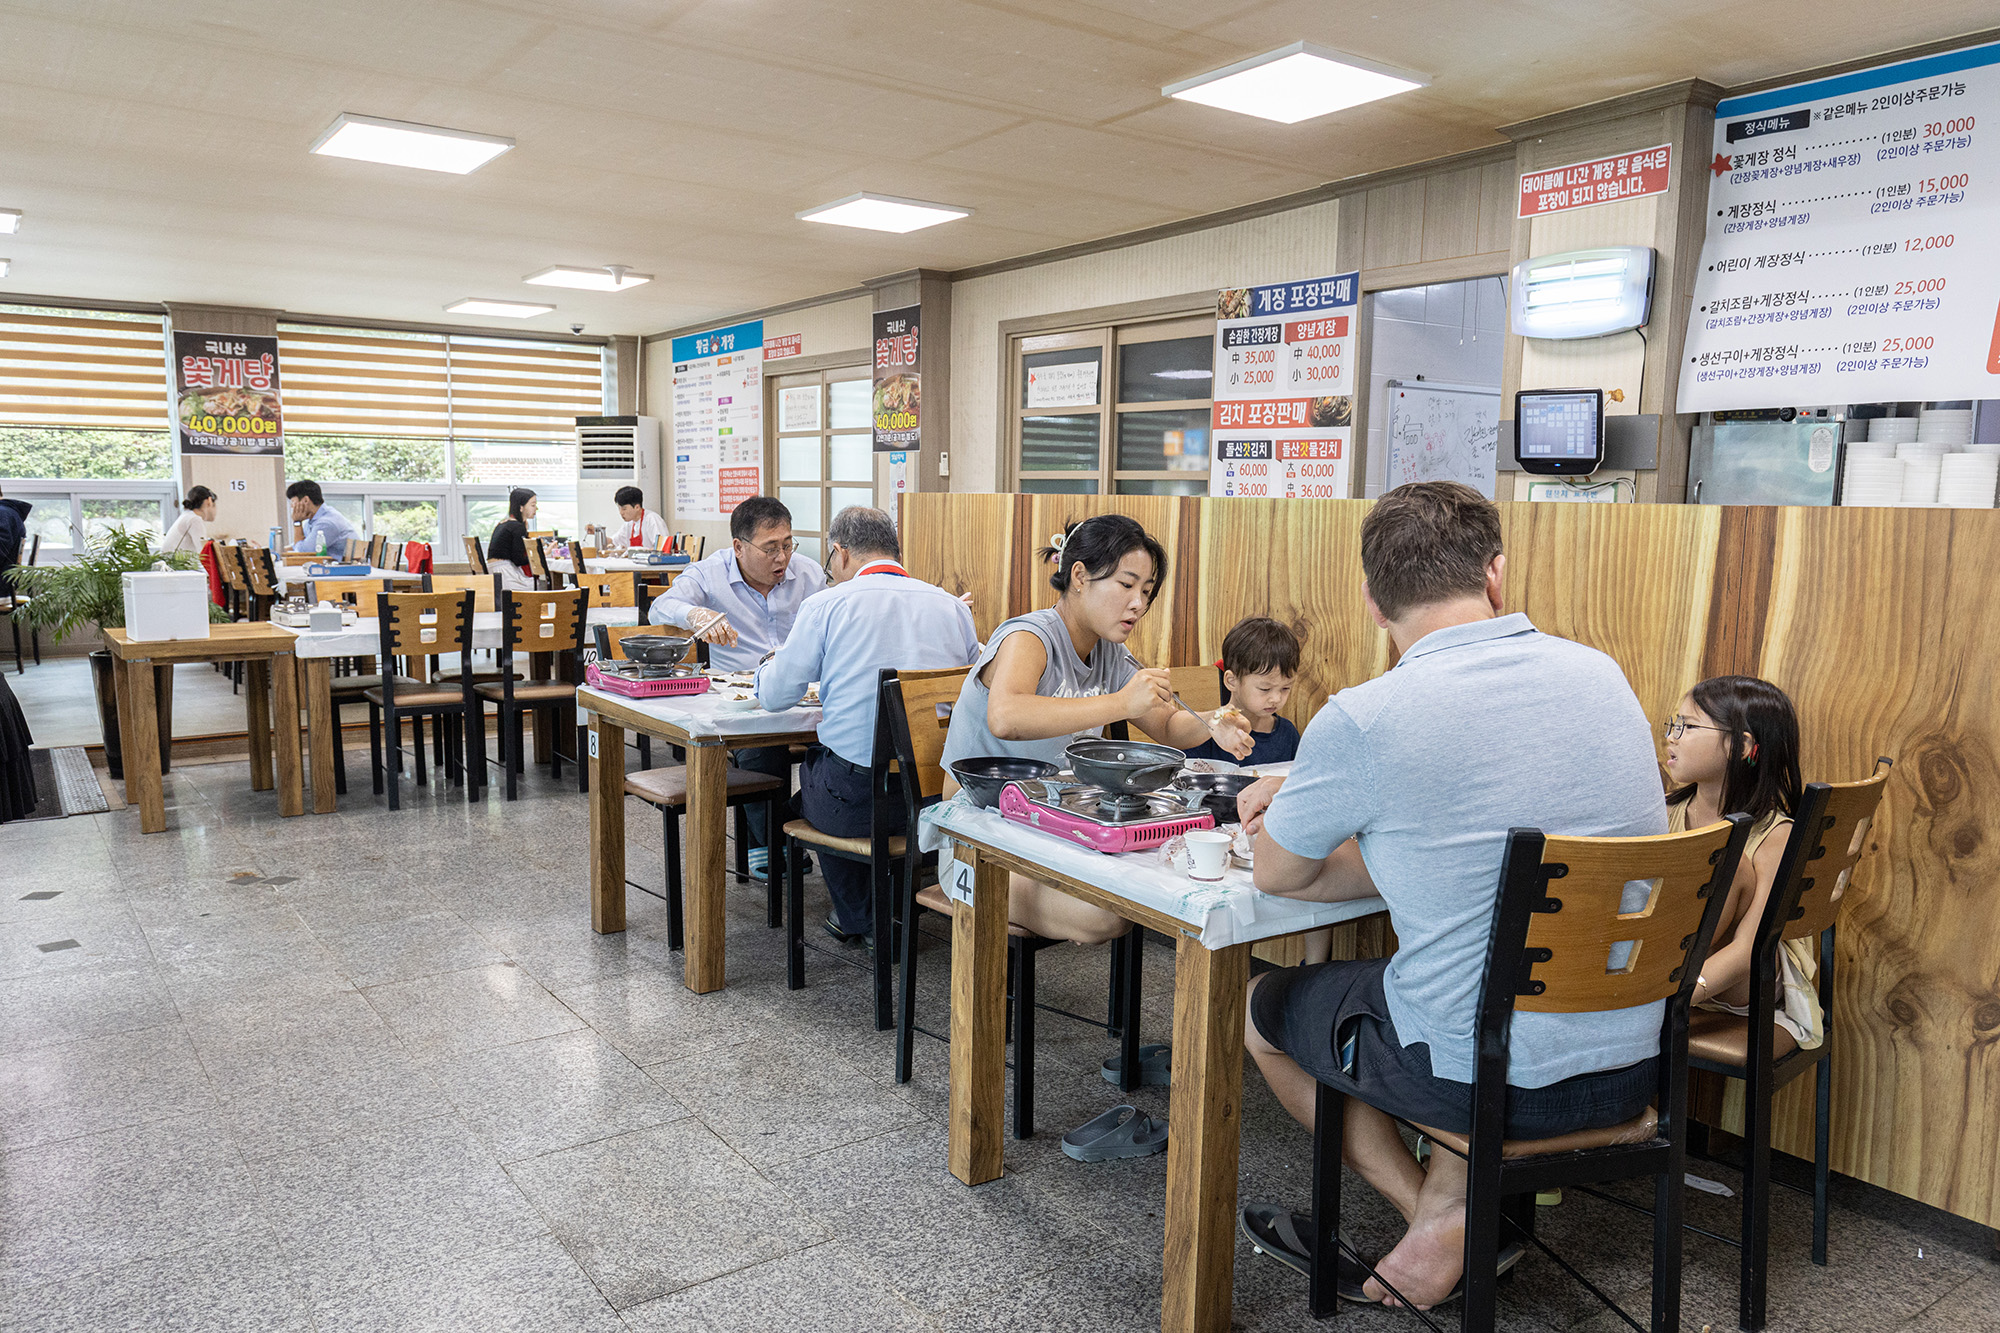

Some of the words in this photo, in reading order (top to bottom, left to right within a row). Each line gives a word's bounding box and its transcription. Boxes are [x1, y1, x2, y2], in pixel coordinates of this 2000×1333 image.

[1871, 81, 1967, 111] 2인이상주문가능
[1744, 117, 1791, 136] 정식메뉴
[1732, 148, 1770, 170] 꽃게장
[1773, 145, 1797, 163] 정식
[1881, 127, 1917, 145] (1인분)
[1922, 116, 1975, 140] 30,000
[1729, 153, 1862, 185] (간장꽃게장+양념게장+새우장)
[1876, 142, 1920, 162] (2인이상
[1922, 134, 1972, 155] 주문가능)
[1522, 172, 1564, 194] 테이블에
[1566, 166, 1590, 185] 나간
[1592, 161, 1615, 181] 게장
[1617, 158, 1629, 176] 및
[1631, 150, 1667, 173] 음식은
[1537, 190, 1569, 212] 포장이
[1572, 185, 1594, 206] 되지
[1597, 176, 1647, 201] 않습니다.
[1728, 199, 1777, 220] 게장정식
[1875, 182, 1912, 200] (1인분)
[1917, 173, 1969, 196] 15,000
[1723, 212, 1811, 235] (간장게장+양념게장)
[1870, 197, 1914, 215] (2인이상
[1915, 190, 1965, 208] 주문가능)
[1716, 256, 1752, 274] 어린이
[1753, 250, 1806, 269] 게장정식
[1861, 241, 1898, 257] (1인분)
[1903, 233, 1955, 254] 12,000
[1258, 287, 1286, 312] 게장
[1290, 278, 1352, 308] 포장판매
[1709, 289, 1810, 315] 갈치조림+게장정식
[1853, 283, 1890, 300] (1인분)
[1893, 276, 1946, 297] 25,000
[1705, 305, 1833, 331] (갈치조림+간장게장+양념게장)
[1846, 299, 1890, 317] (2인이상
[1891, 296, 1941, 314] 주문가능)
[886, 320, 906, 334] 국내산
[1229, 327, 1250, 345] 손질한
[1250, 325, 1279, 343] 간장게장
[1297, 319, 1336, 340] 양념게장
[205, 340, 247, 356] 국내산
[876, 325, 919, 369] 꽃게탕
[1231, 352, 1240, 365] 中
[1244, 349, 1275, 366] 35,000
[1293, 347, 1303, 360] 中
[1306, 343, 1341, 361] 40,000
[1699, 343, 1799, 367] 생선구이+게장정식
[1842, 340, 1877, 356] (1인분)
[1881, 335, 1935, 355] 25,000
[182, 352, 275, 391] 꽃게탕
[1230, 372, 1239, 385] 小
[1243, 369, 1274, 385] 25,000
[1292, 368, 1302, 382] 小
[1306, 364, 1340, 382] 30,000
[1696, 362, 1822, 384] (생선구이+간장게장+양념게장)
[1836, 357, 1879, 374] (2인이상
[1880, 355, 1929, 373] 주문가능)
[876, 411, 917, 432] 40,000원
[1220, 404, 1244, 425] 김치
[1247, 401, 1307, 424] 포장판매
[189, 415, 277, 436] 40,000원
[1225, 442, 1268, 457] 돌산갓김치
[1282, 441, 1338, 457] 돌산갓물김치
[1240, 463, 1268, 478] 60,000
[1301, 463, 1334, 479] 60,000
[231, 480, 245, 491] 15
[1238, 482, 1268, 498] 36,000
[1301, 484, 1333, 498] 36,000
[584, 650, 597, 663] 10
[590, 734, 597, 756] 8
[955, 868, 972, 901] 4
